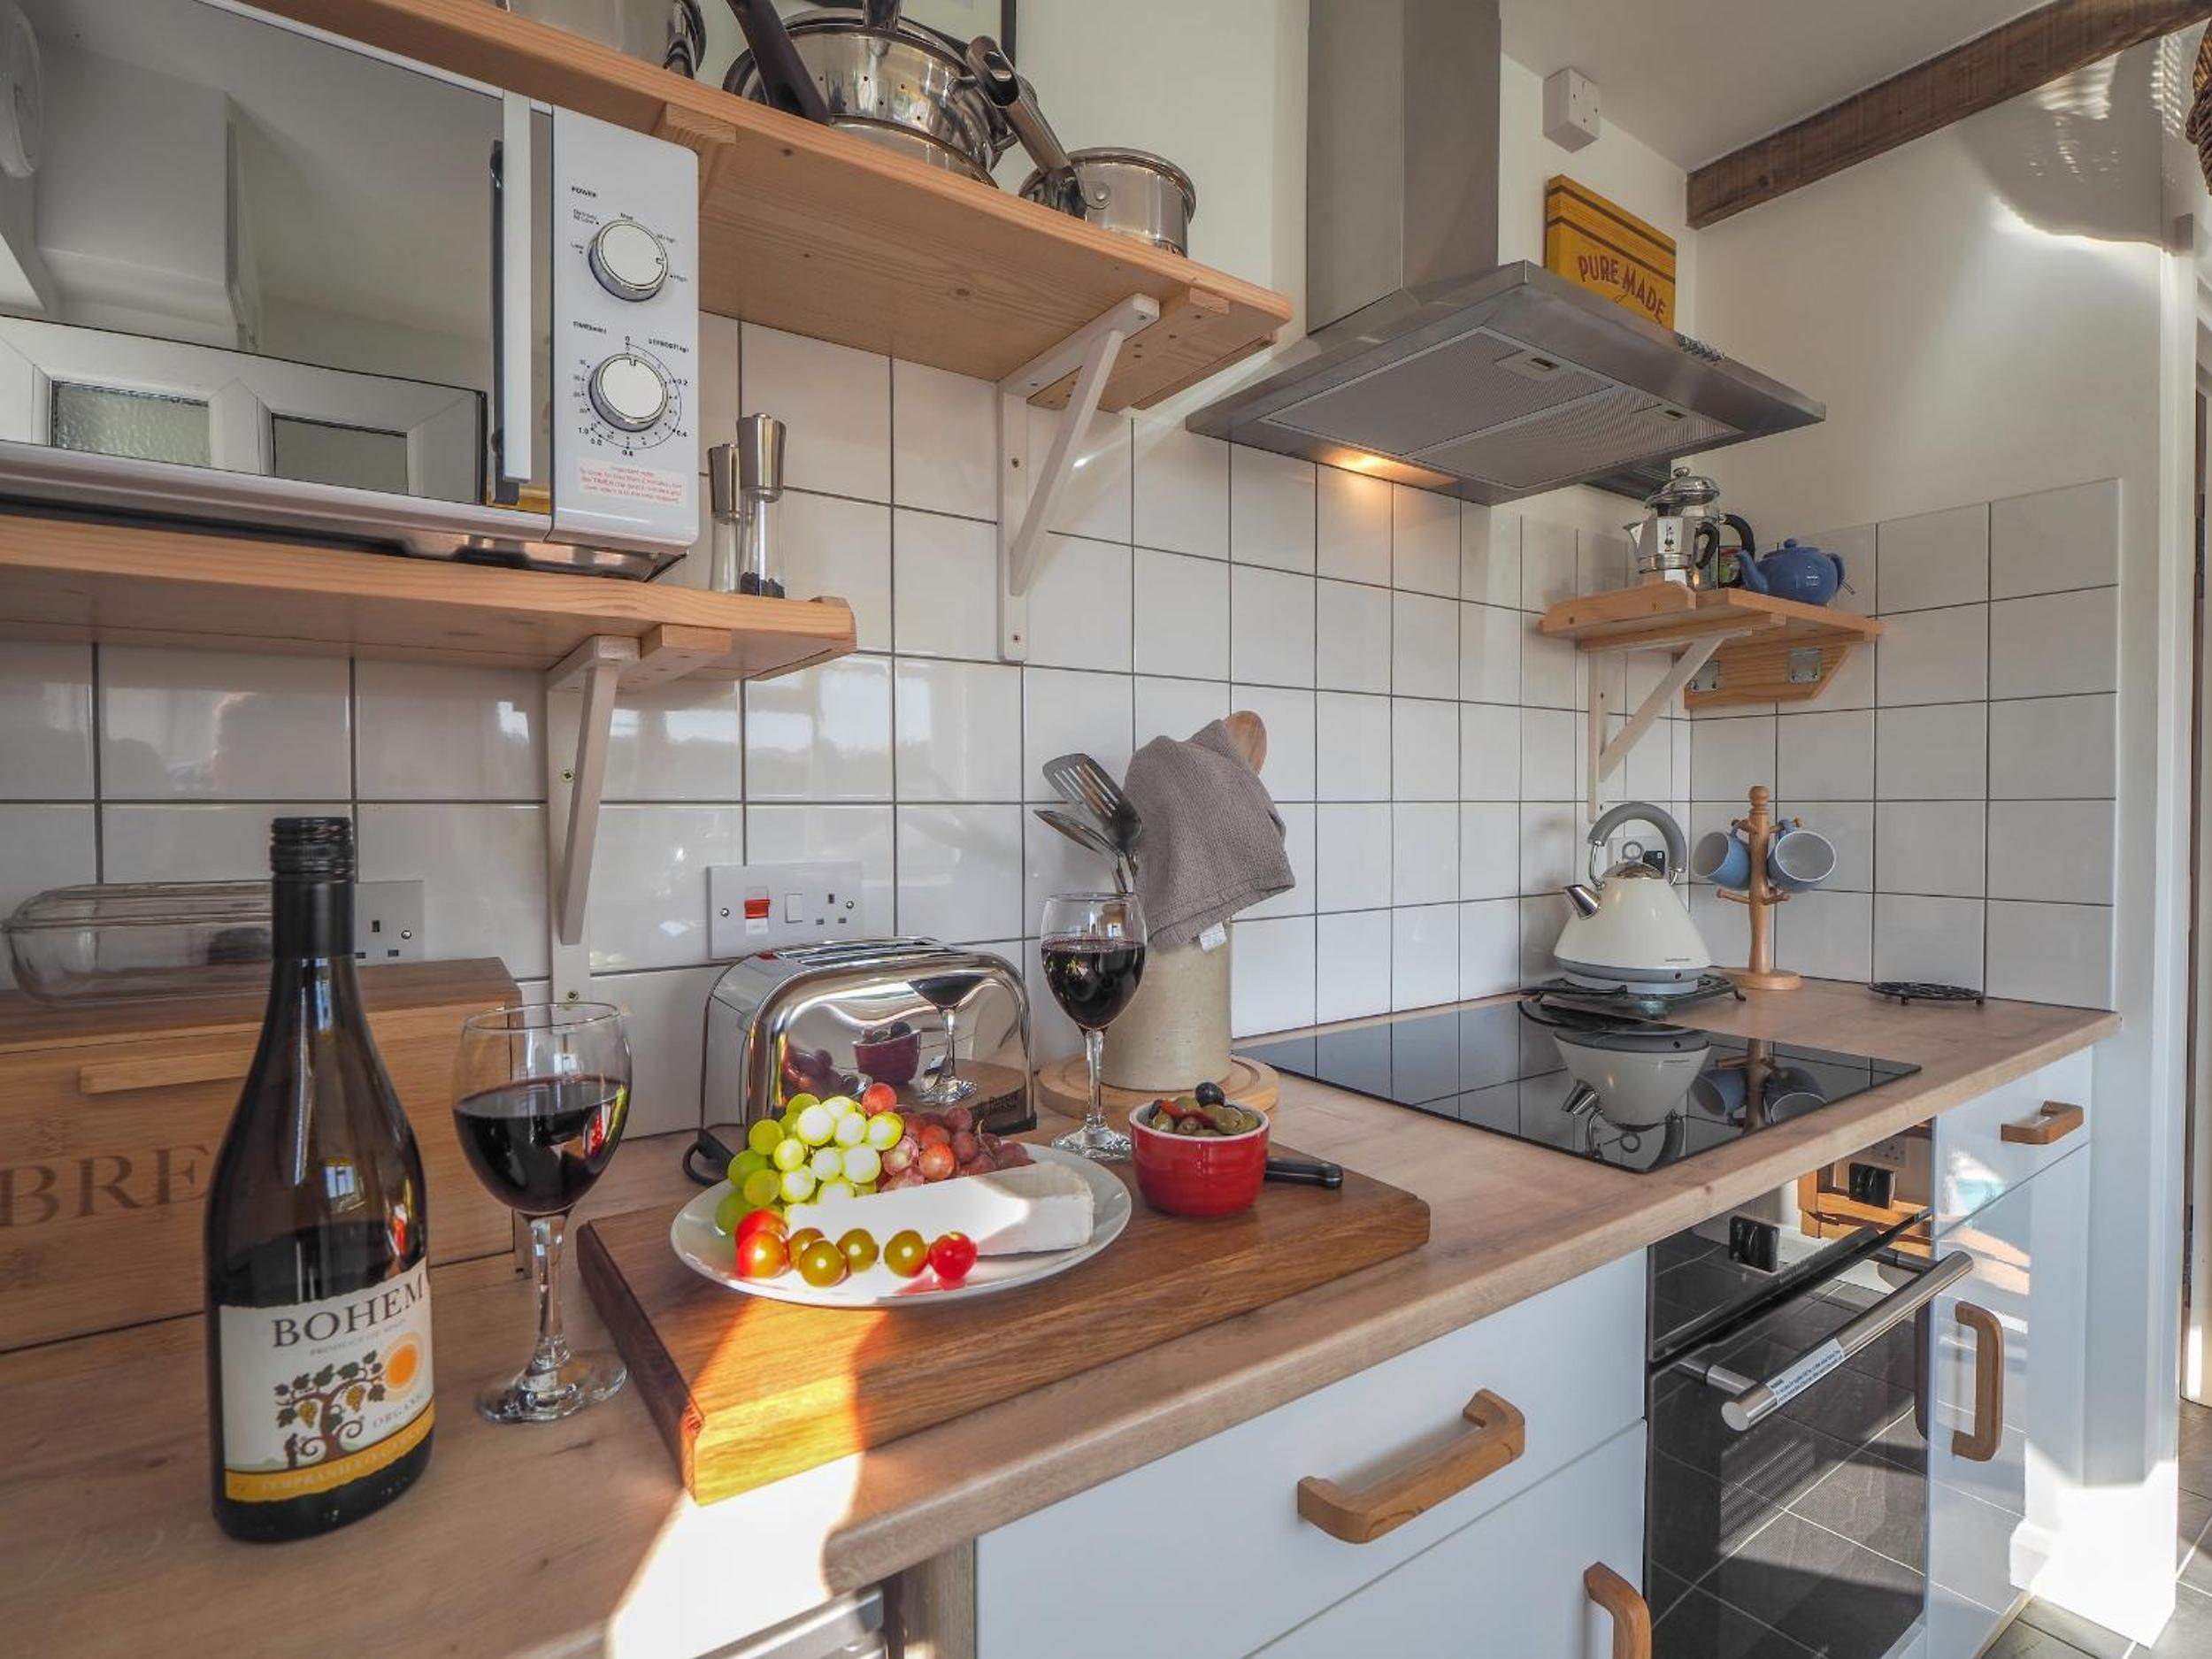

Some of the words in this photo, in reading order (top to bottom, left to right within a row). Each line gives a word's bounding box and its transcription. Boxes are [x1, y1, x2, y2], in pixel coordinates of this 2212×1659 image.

[1578, 255, 1620, 285] PURE
[1622, 265, 1666, 324] MADE
[272, 1272, 425, 1348] BOHEM
